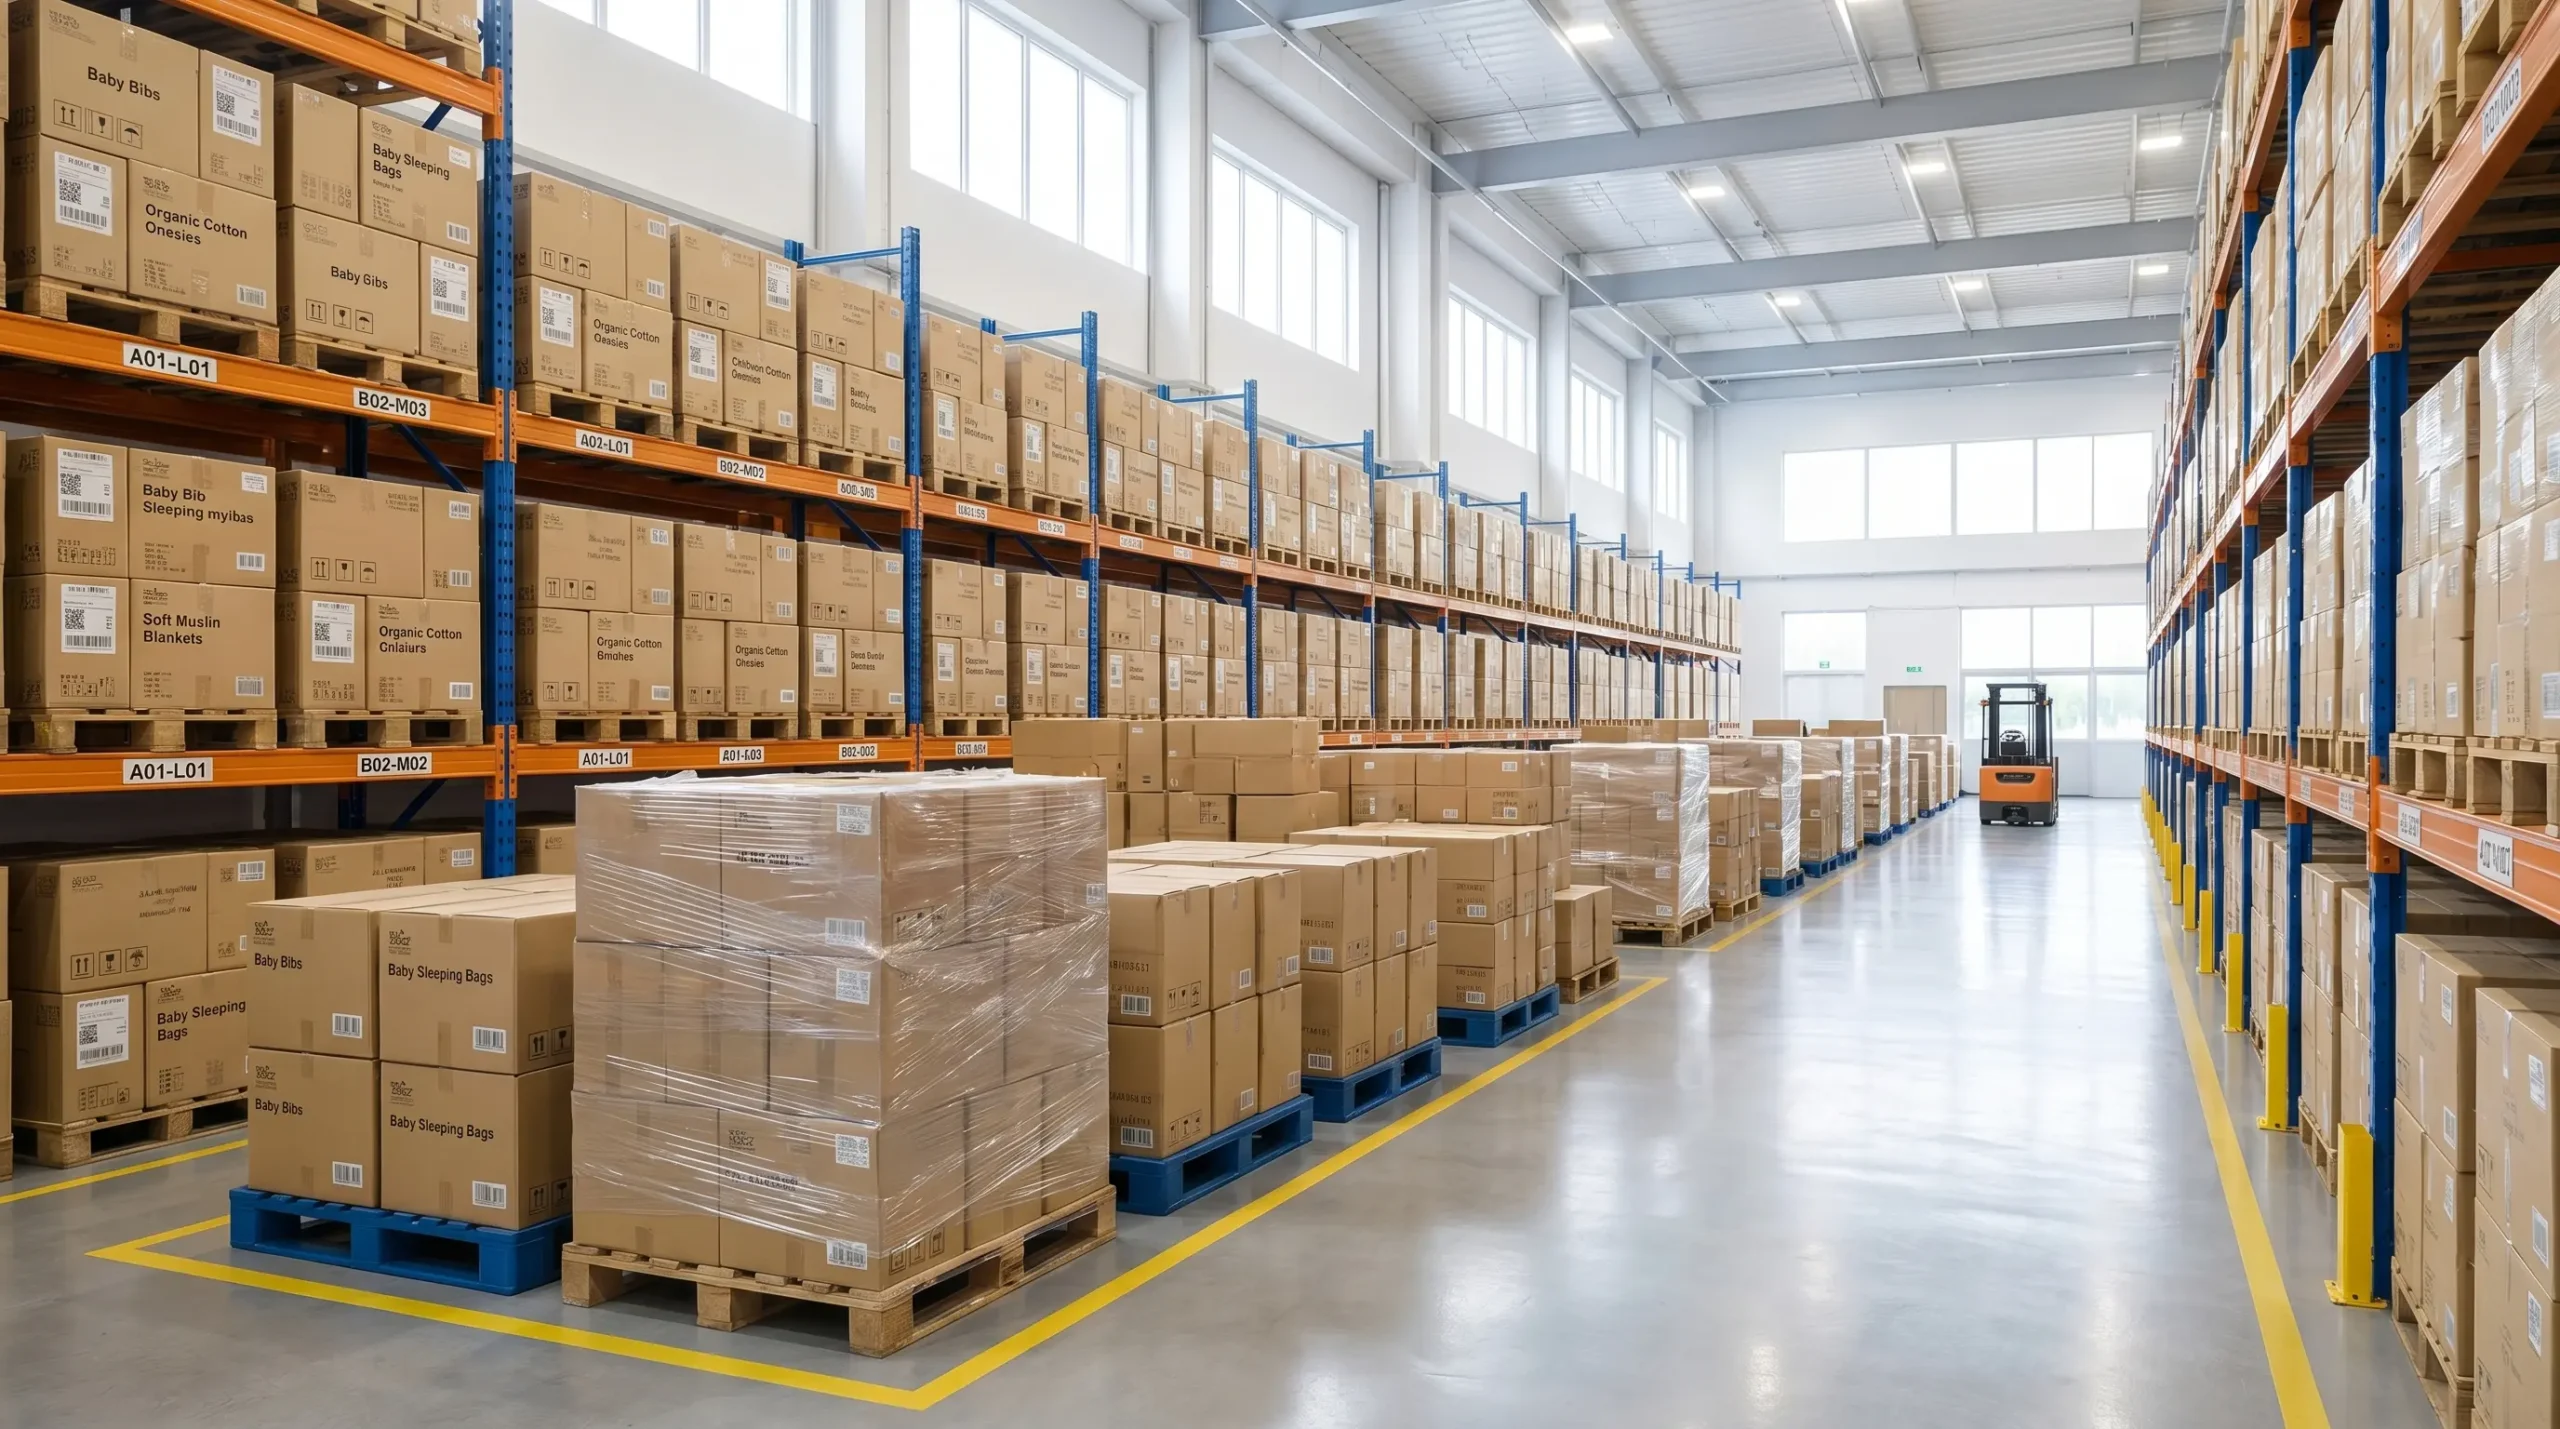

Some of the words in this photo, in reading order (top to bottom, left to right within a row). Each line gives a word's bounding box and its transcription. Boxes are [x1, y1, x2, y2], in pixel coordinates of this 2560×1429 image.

[88, 66, 124, 92] Baby
[129, 80, 161, 101] Bibs
[373, 143, 401, 165] Baby
[404, 154, 450, 181] Sleeping
[373, 160, 402, 179] Bags
[145, 204, 200, 227] Organic
[203, 218, 248, 240] Cotton
[145, 221, 201, 245] Onesies
[331, 266, 360, 285] Baby
[594, 319, 628, 336] Organic
[630, 328, 660, 344] Cotton
[130, 348, 209, 378] A01-L01
[765, 366, 791, 381] Cotton
[358, 391, 427, 417] B02-M03
[581, 434, 629, 454] A02-L01
[720, 460, 765, 479] B02-M02
[143, 484, 178, 502] Baby
[183, 488, 206, 502] Bib
[143, 501, 204, 521] Sleeping
[143, 613, 172, 626] Soft
[176, 615, 221, 628] Muslin
[143, 630, 203, 645] Blankets
[379, 626, 424, 640] Organic
[426, 628, 462, 640] Cotton
[633, 638, 663, 649] Cotton
[361, 756, 427, 773] B02-M02
[582, 751, 629, 766] A01-L01
[129, 762, 206, 780] A01-L01
[254, 953, 278, 970] Baby
[280, 955, 303, 970] Bibs
[388, 963, 414, 981] Baby
[417, 965, 463, 985] Sleeping
[465, 969, 494, 986] Bags
[157, 1010, 188, 1025] Baby
[192, 1001, 246, 1019] Sleeping
[157, 1027, 188, 1041] Bags
[255, 1098, 279, 1115] Baby
[282, 1101, 303, 1116] Bibs
[390, 1114, 416, 1132] Baby
[418, 1118, 464, 1139] Sleeping
[466, 1124, 494, 1142] Bags
